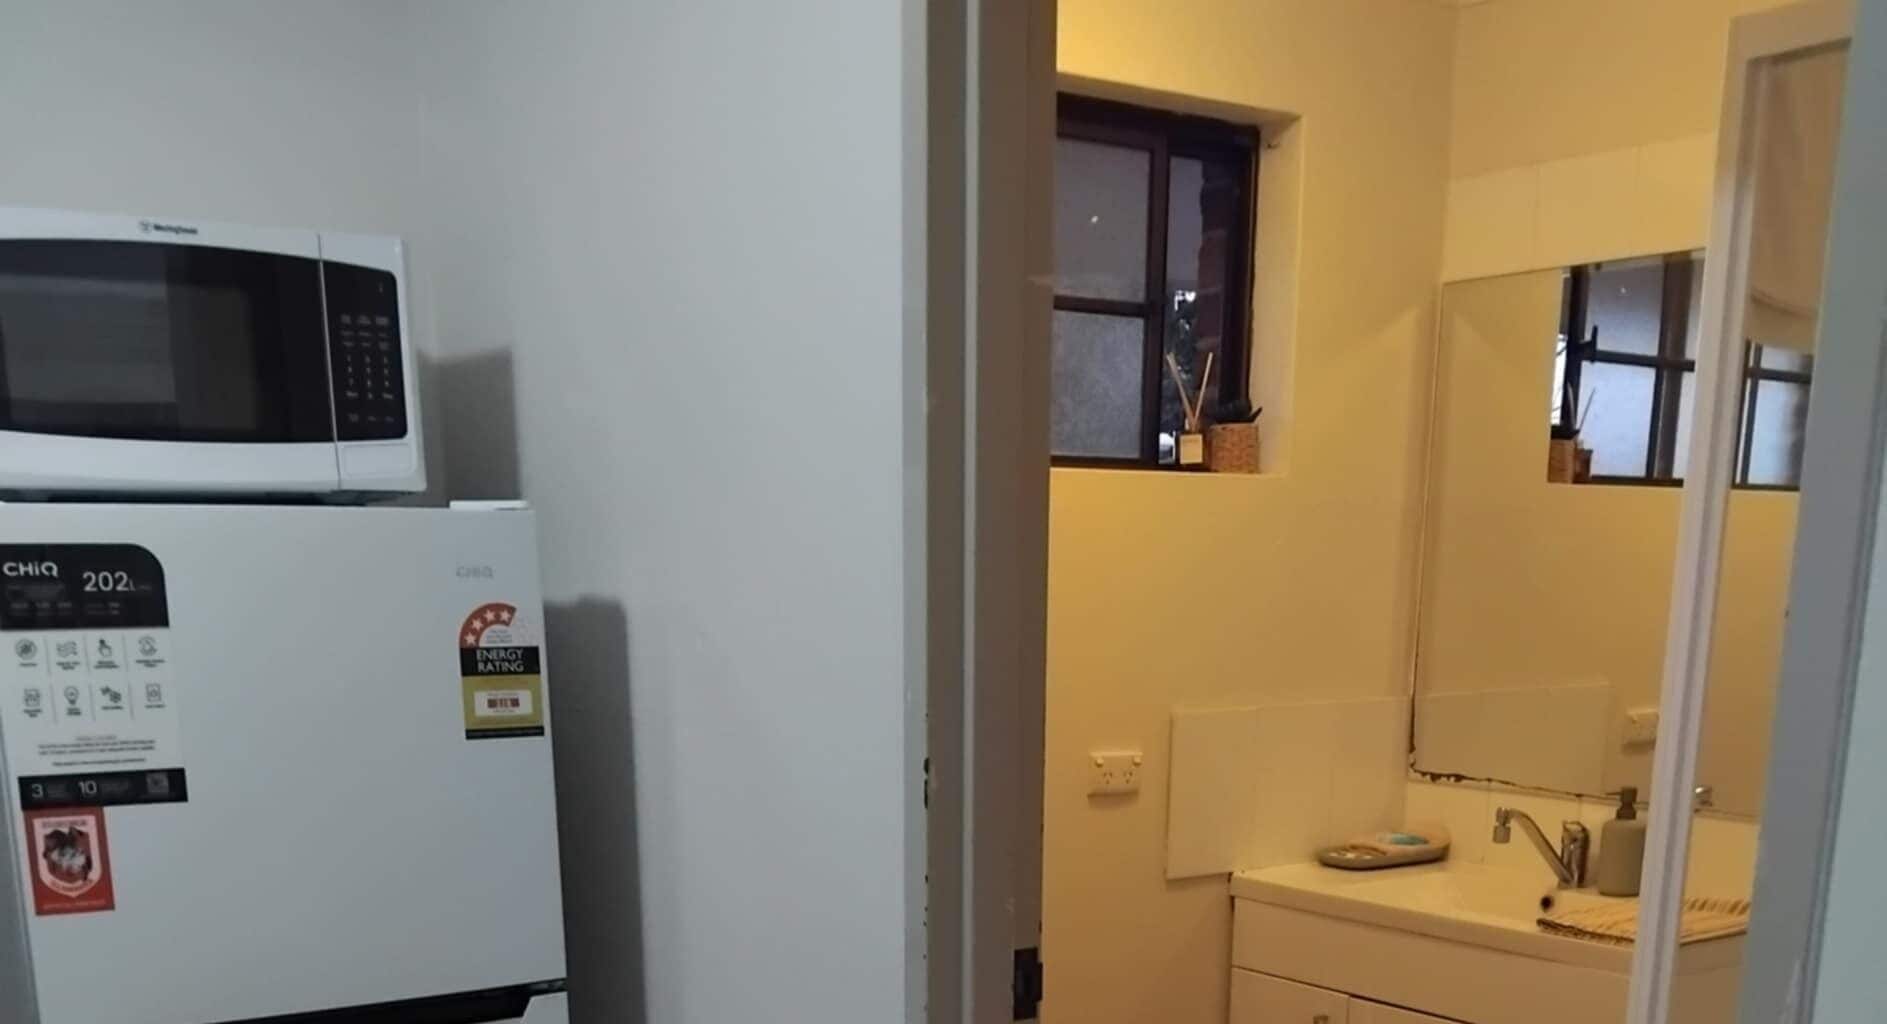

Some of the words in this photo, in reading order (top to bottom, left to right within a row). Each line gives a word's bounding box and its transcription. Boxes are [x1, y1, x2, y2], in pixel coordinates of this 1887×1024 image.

[476, 649, 524, 661] ENERGY
[477, 661, 525, 673] RATING
[31, 783, 43, 798] 3
[78, 780, 97, 794] 10
